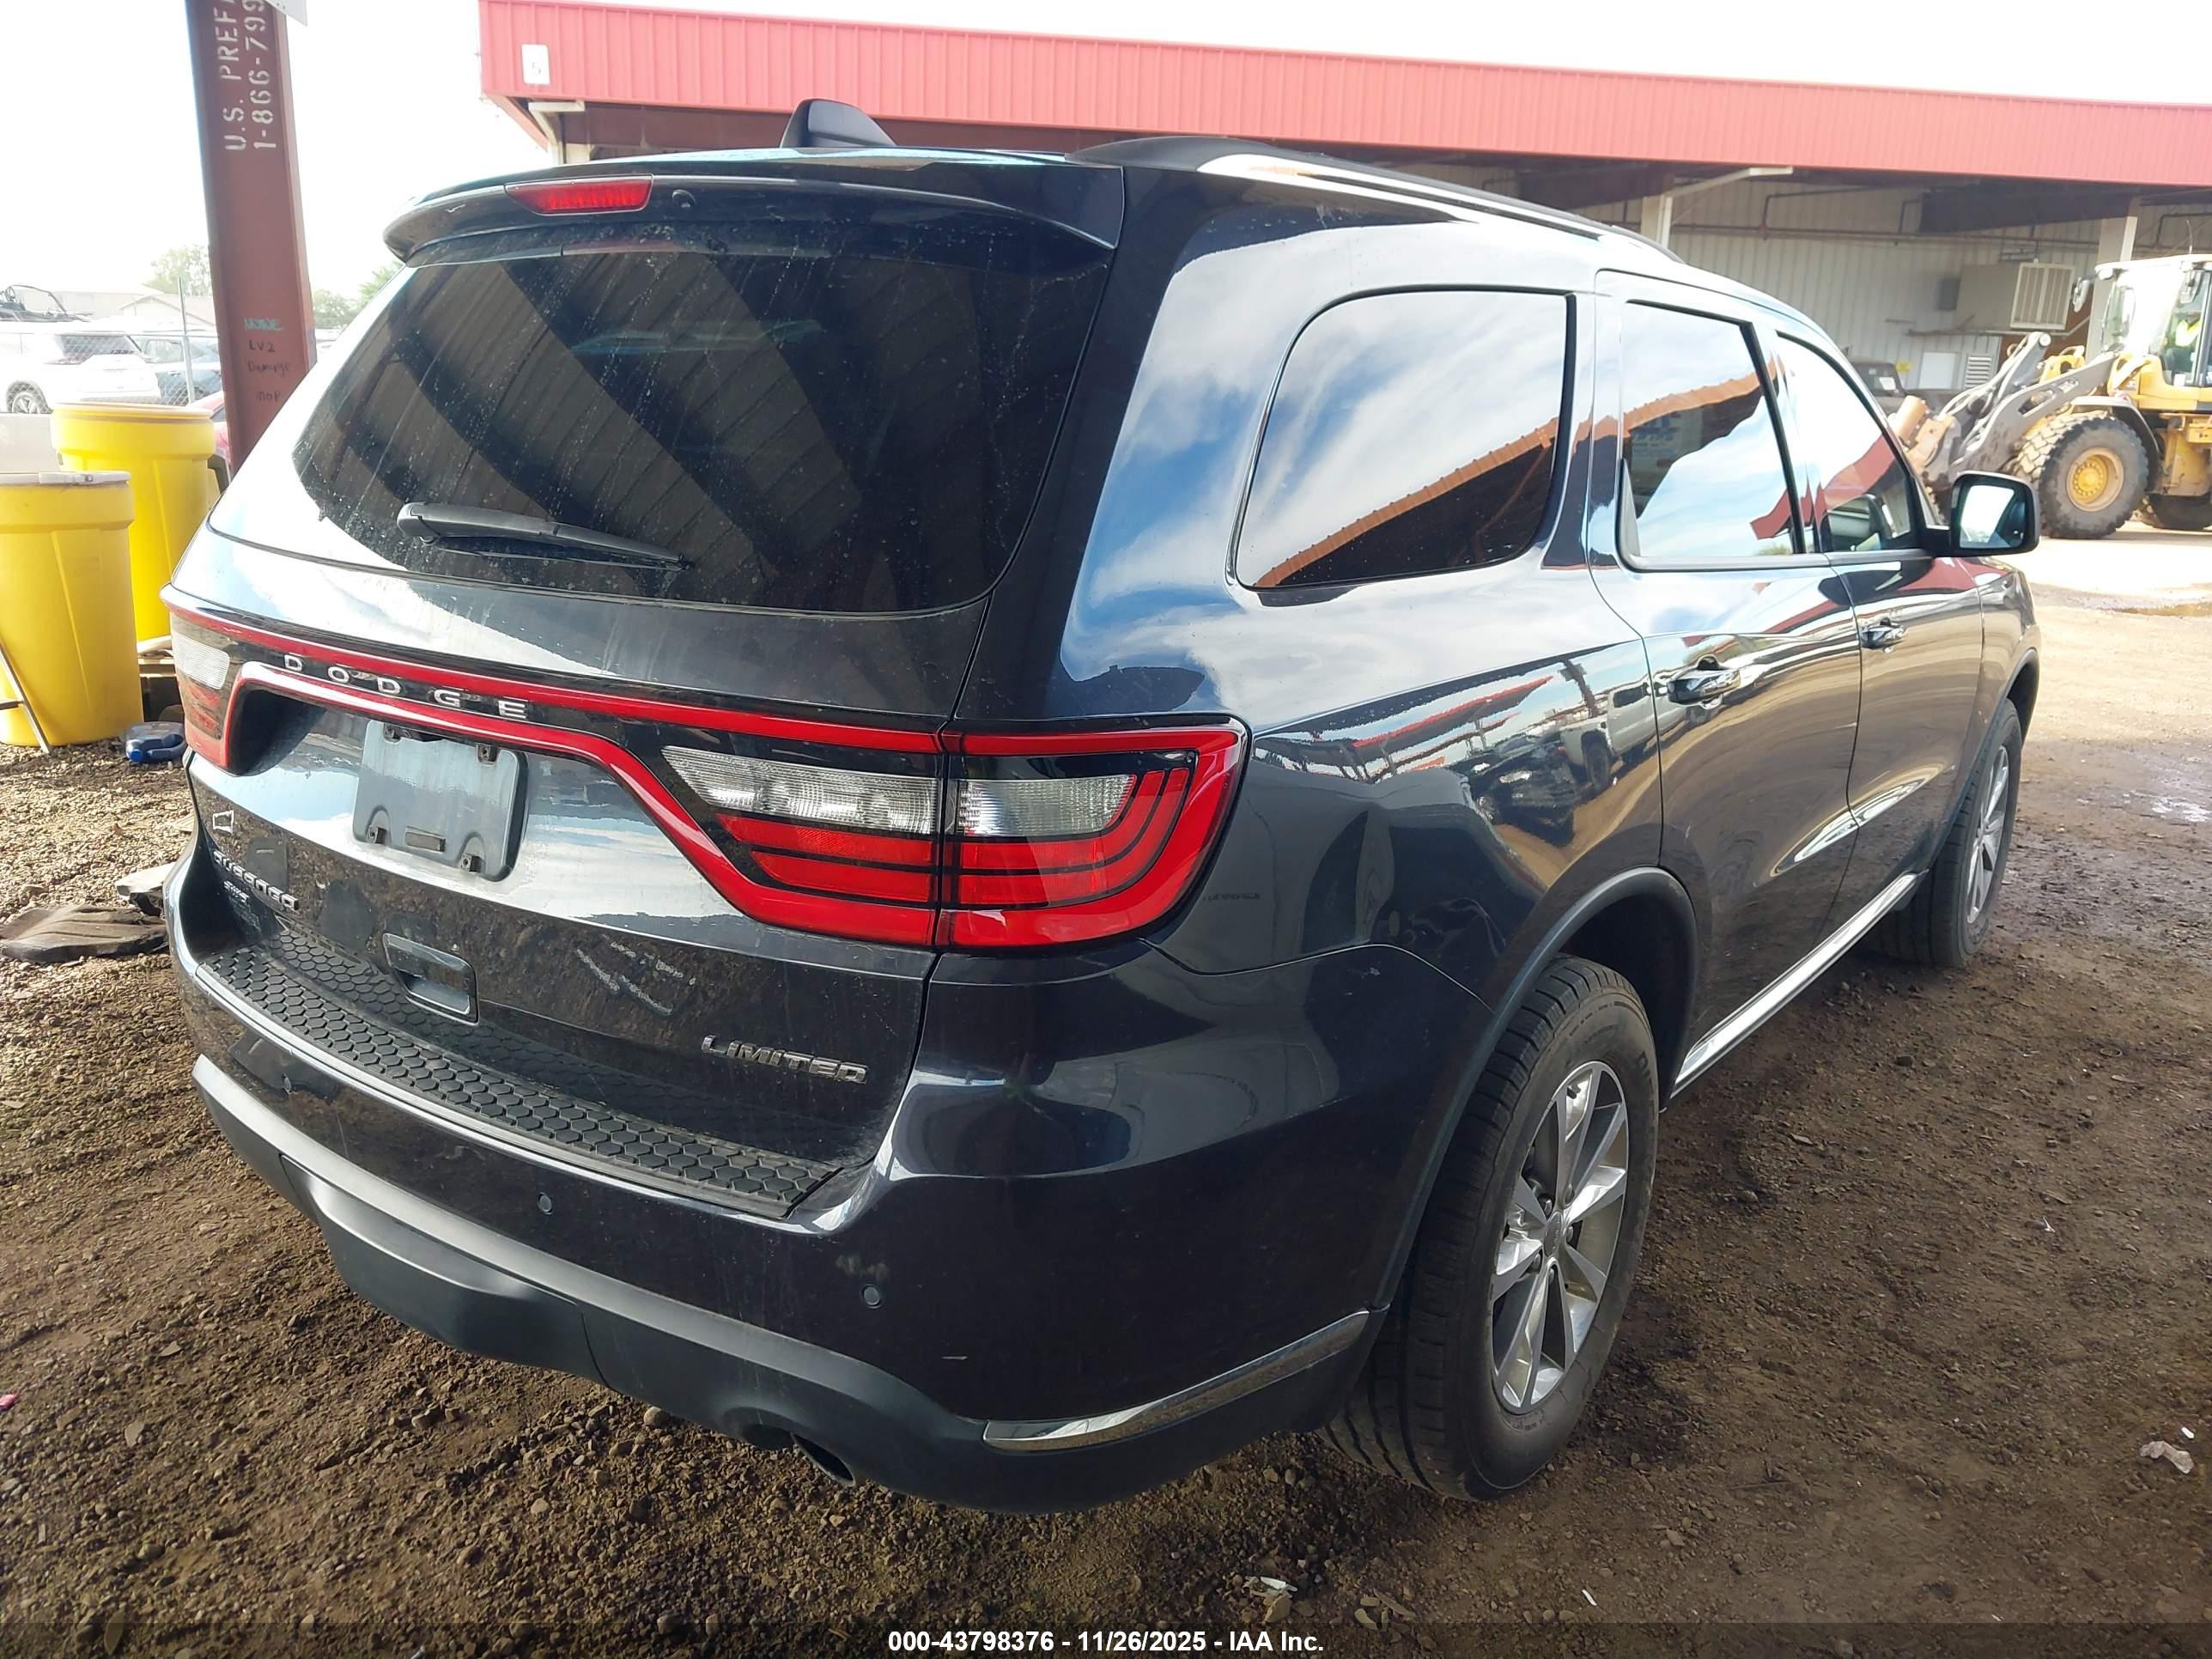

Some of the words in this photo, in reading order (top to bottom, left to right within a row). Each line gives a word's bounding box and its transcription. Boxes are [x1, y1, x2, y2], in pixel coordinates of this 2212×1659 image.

[213, 0, 242, 81] PREF
[222, 99, 246, 151] U.S.
[284, 653, 526, 720] DODGE
[701, 1034, 870, 1085] LIMITED
